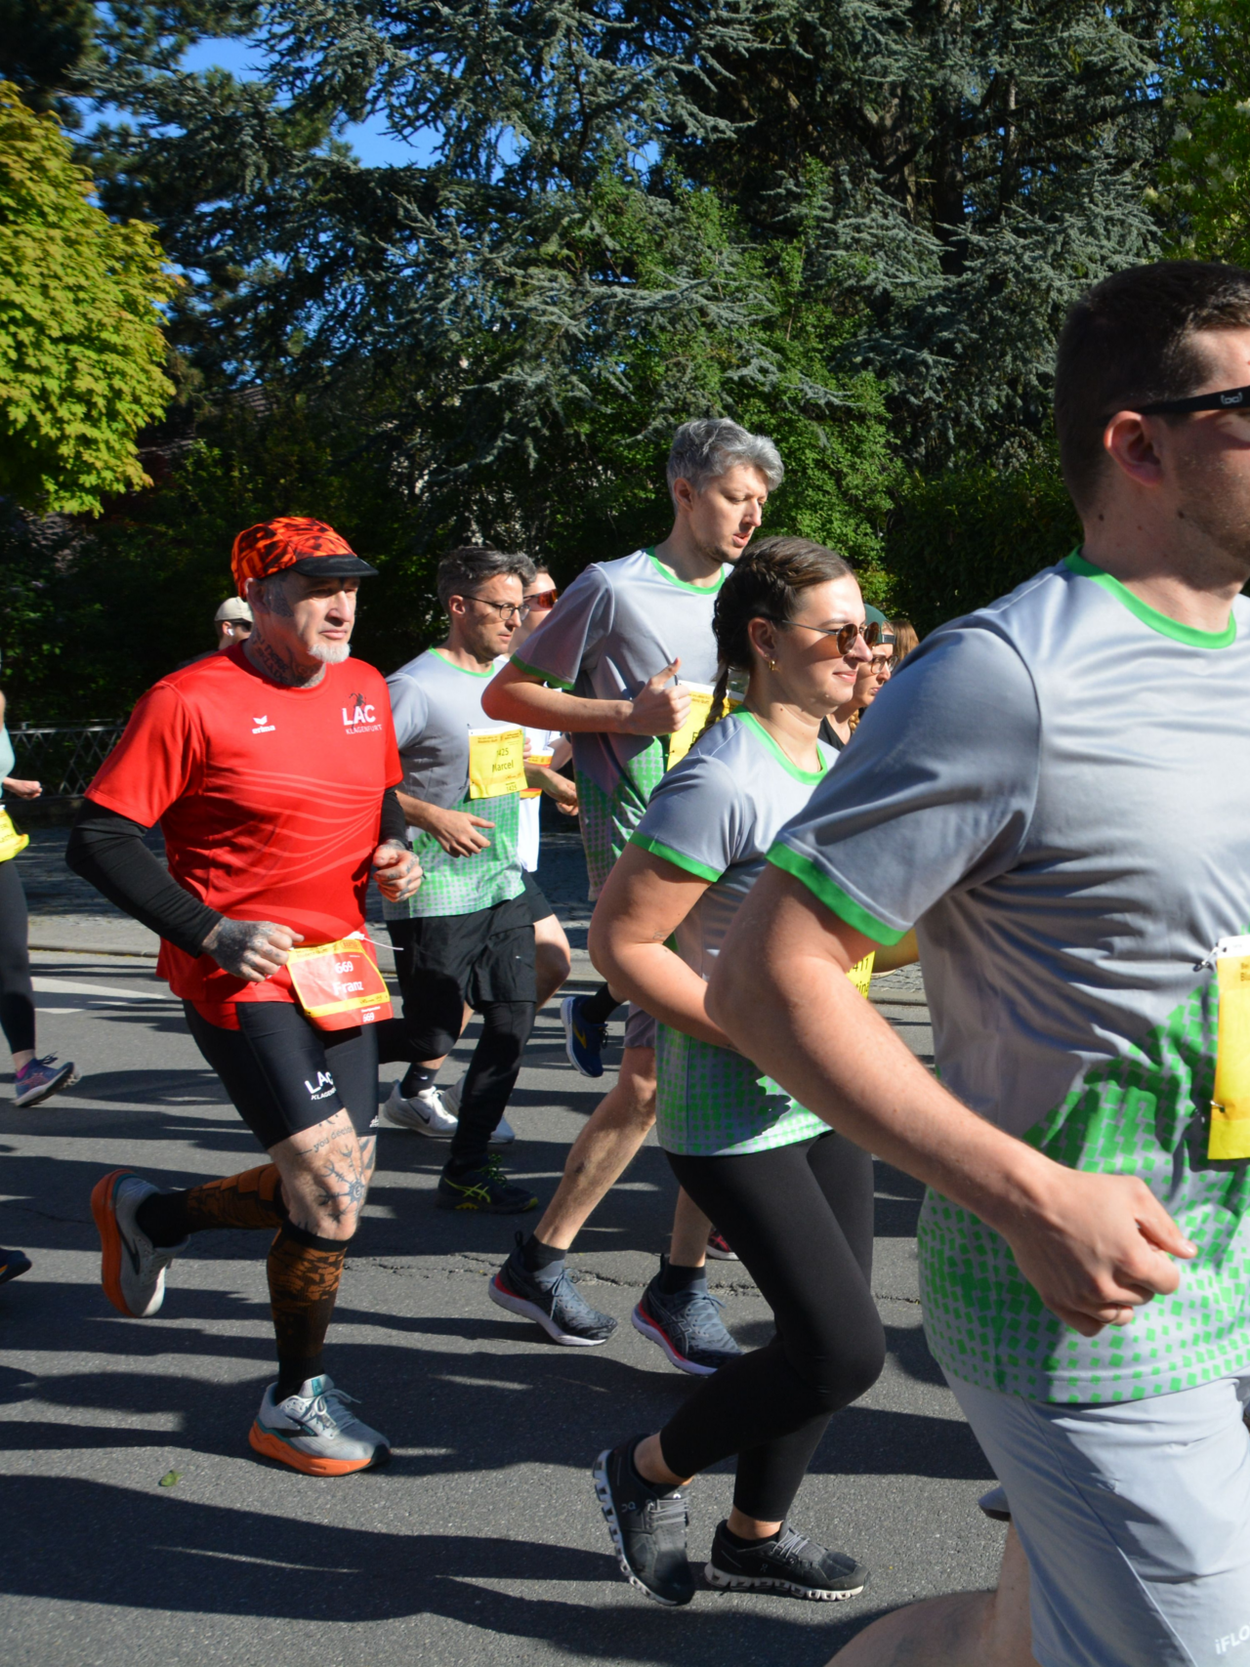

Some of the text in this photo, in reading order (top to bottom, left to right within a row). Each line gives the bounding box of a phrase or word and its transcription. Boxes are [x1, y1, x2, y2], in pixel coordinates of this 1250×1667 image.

[342, 705, 376, 726] LAC
[492, 759, 514, 773] Marcel
[334, 960, 353, 974] 669
[332, 980, 364, 996] Franz
[304, 1071, 334, 1094] LAC
